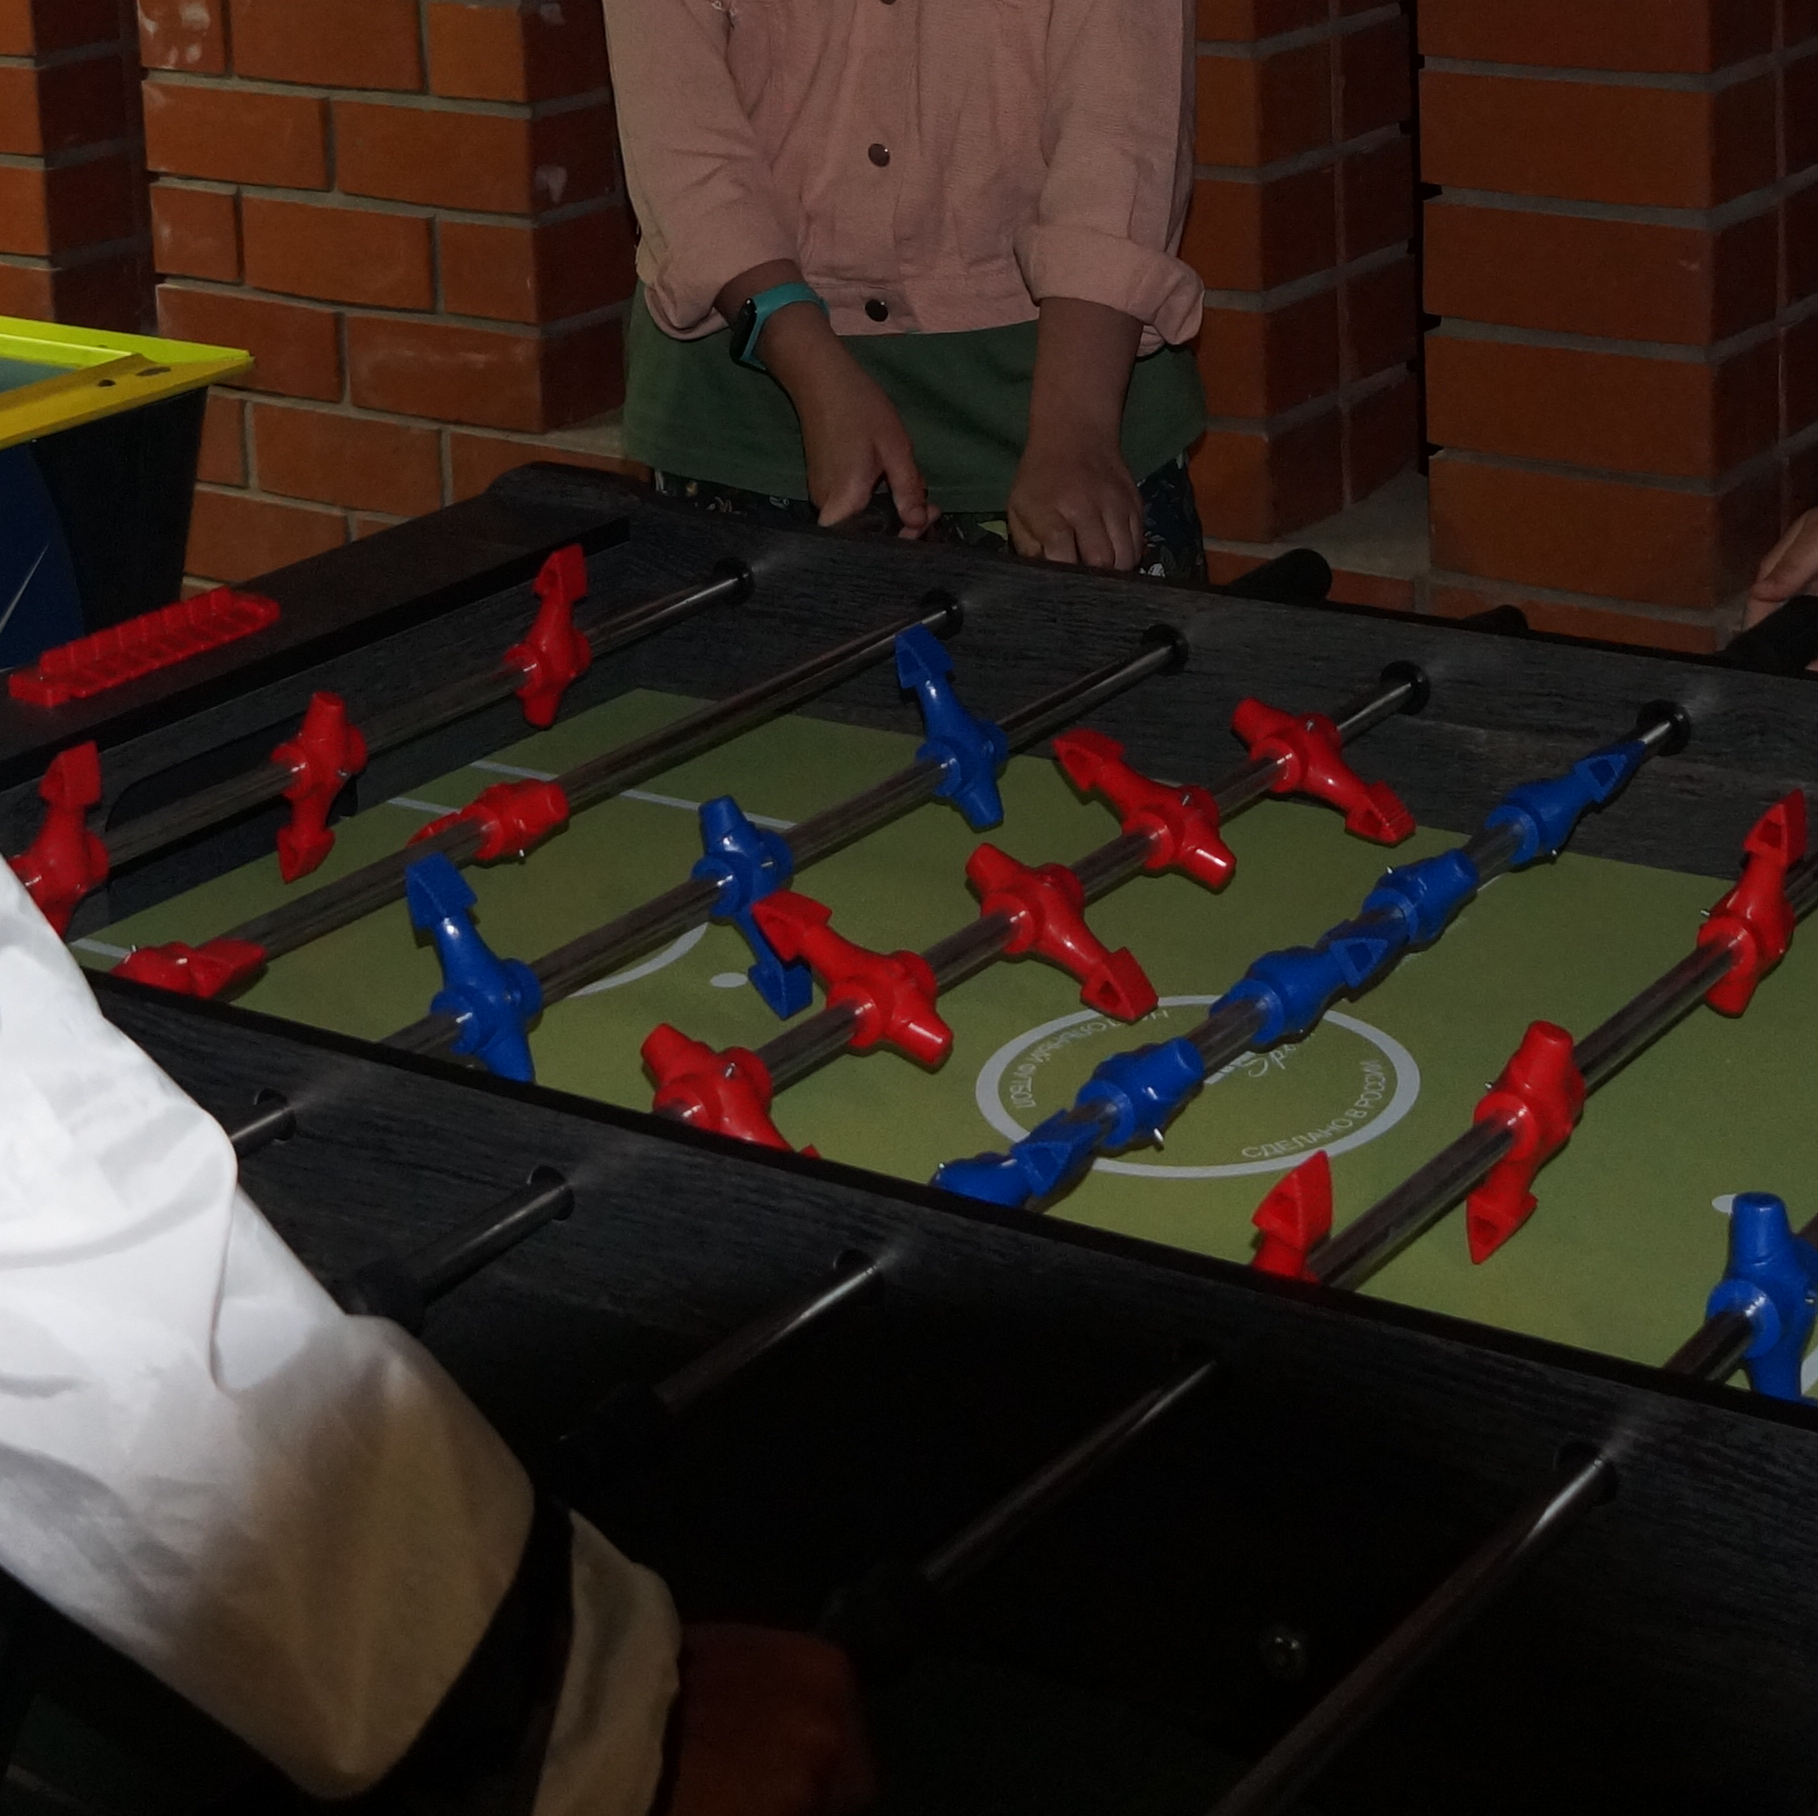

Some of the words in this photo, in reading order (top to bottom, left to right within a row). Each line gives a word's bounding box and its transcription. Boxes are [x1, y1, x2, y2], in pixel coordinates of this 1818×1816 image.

[1353, 1058, 1387, 1109] РОССИИ
[1344, 1107, 1368, 1120] В
[1241, 1117, 1354, 1158] СДЕЛАНО
